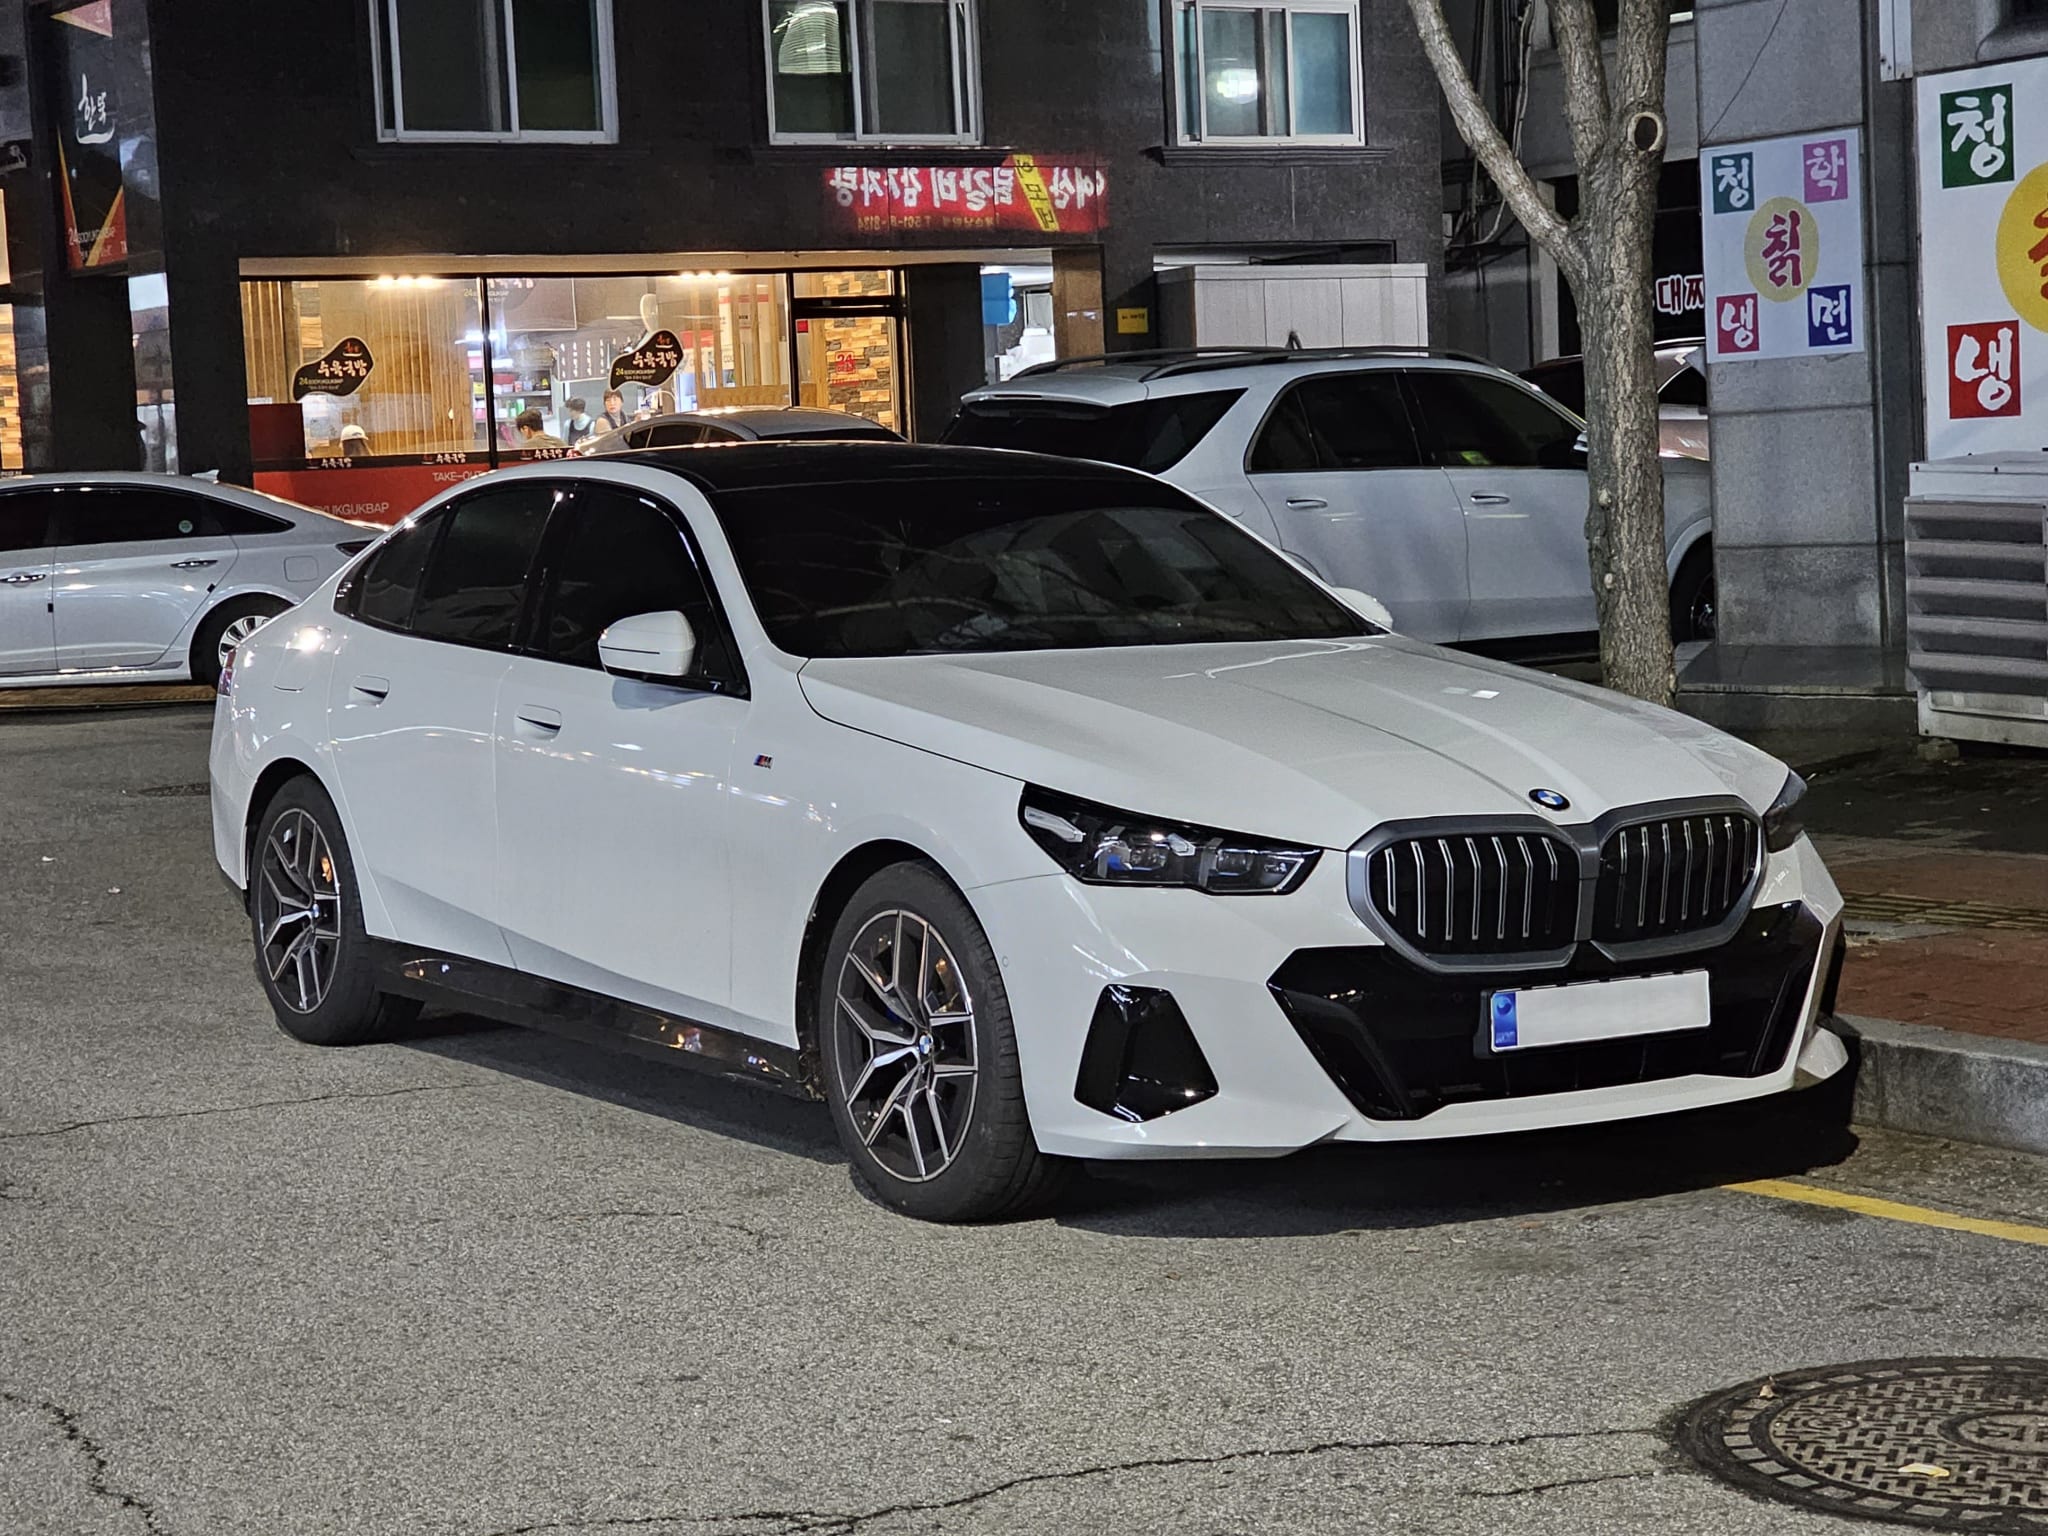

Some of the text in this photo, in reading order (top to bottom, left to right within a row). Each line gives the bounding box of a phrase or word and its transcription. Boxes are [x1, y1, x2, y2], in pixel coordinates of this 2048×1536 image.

[1946, 93, 2006, 178] 청
[1715, 145, 1845, 208] 청 학
[1762, 209, 1803, 288] 칡
[1720, 289, 1848, 348] 냉 면
[1955, 327, 2012, 411] 냉
